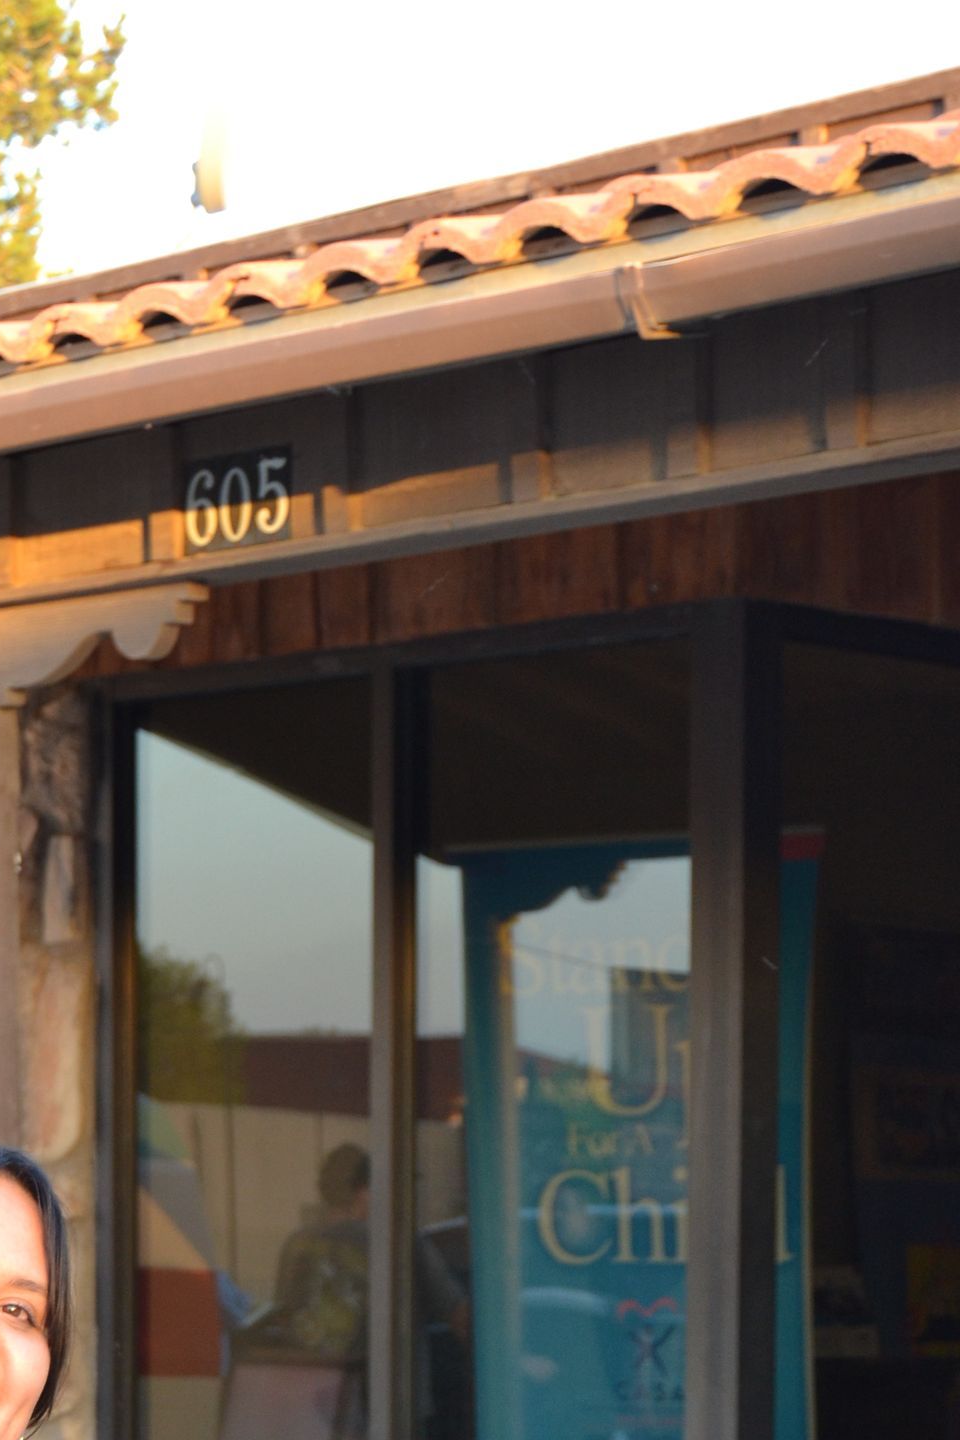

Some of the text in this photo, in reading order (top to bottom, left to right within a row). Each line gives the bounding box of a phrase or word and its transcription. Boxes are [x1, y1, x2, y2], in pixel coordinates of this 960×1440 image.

[185, 456, 290, 548] 605
[567, 1120, 655, 1158] For A
[541, 1161, 796, 1265] Chi
